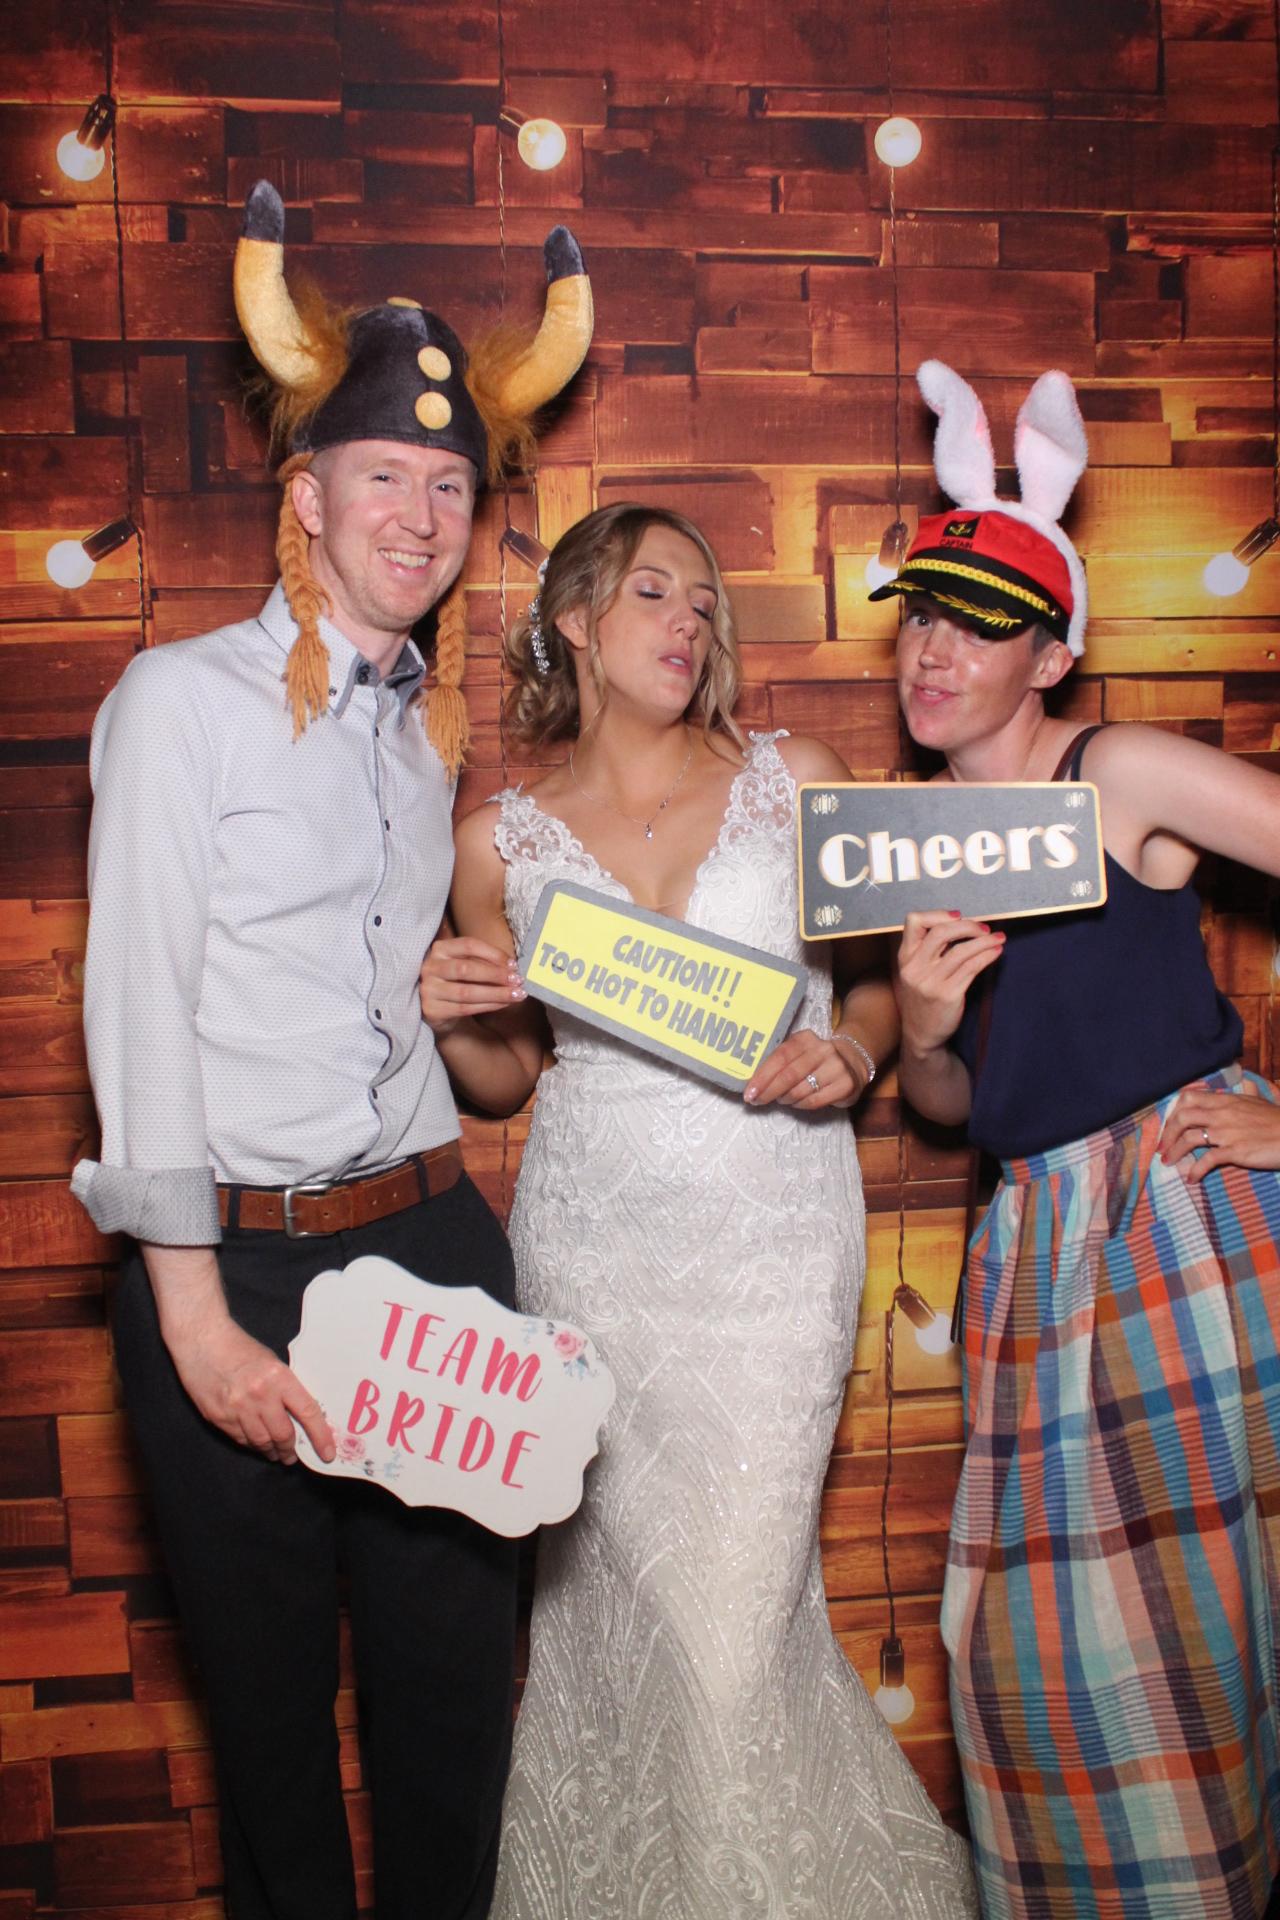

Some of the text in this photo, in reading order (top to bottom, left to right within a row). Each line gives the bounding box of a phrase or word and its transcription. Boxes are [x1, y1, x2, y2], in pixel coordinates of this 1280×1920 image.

[939, 538, 973, 550] CAPTAIN
[818, 822, 1079, 888] Cheers
[539, 942, 766, 1068] TOO HOT TO HANDLE
[612, 935, 743, 1008] CAUTION!!
[380, 1301, 543, 1402] TEAM
[347, 1379, 541, 1489] BRIDE
